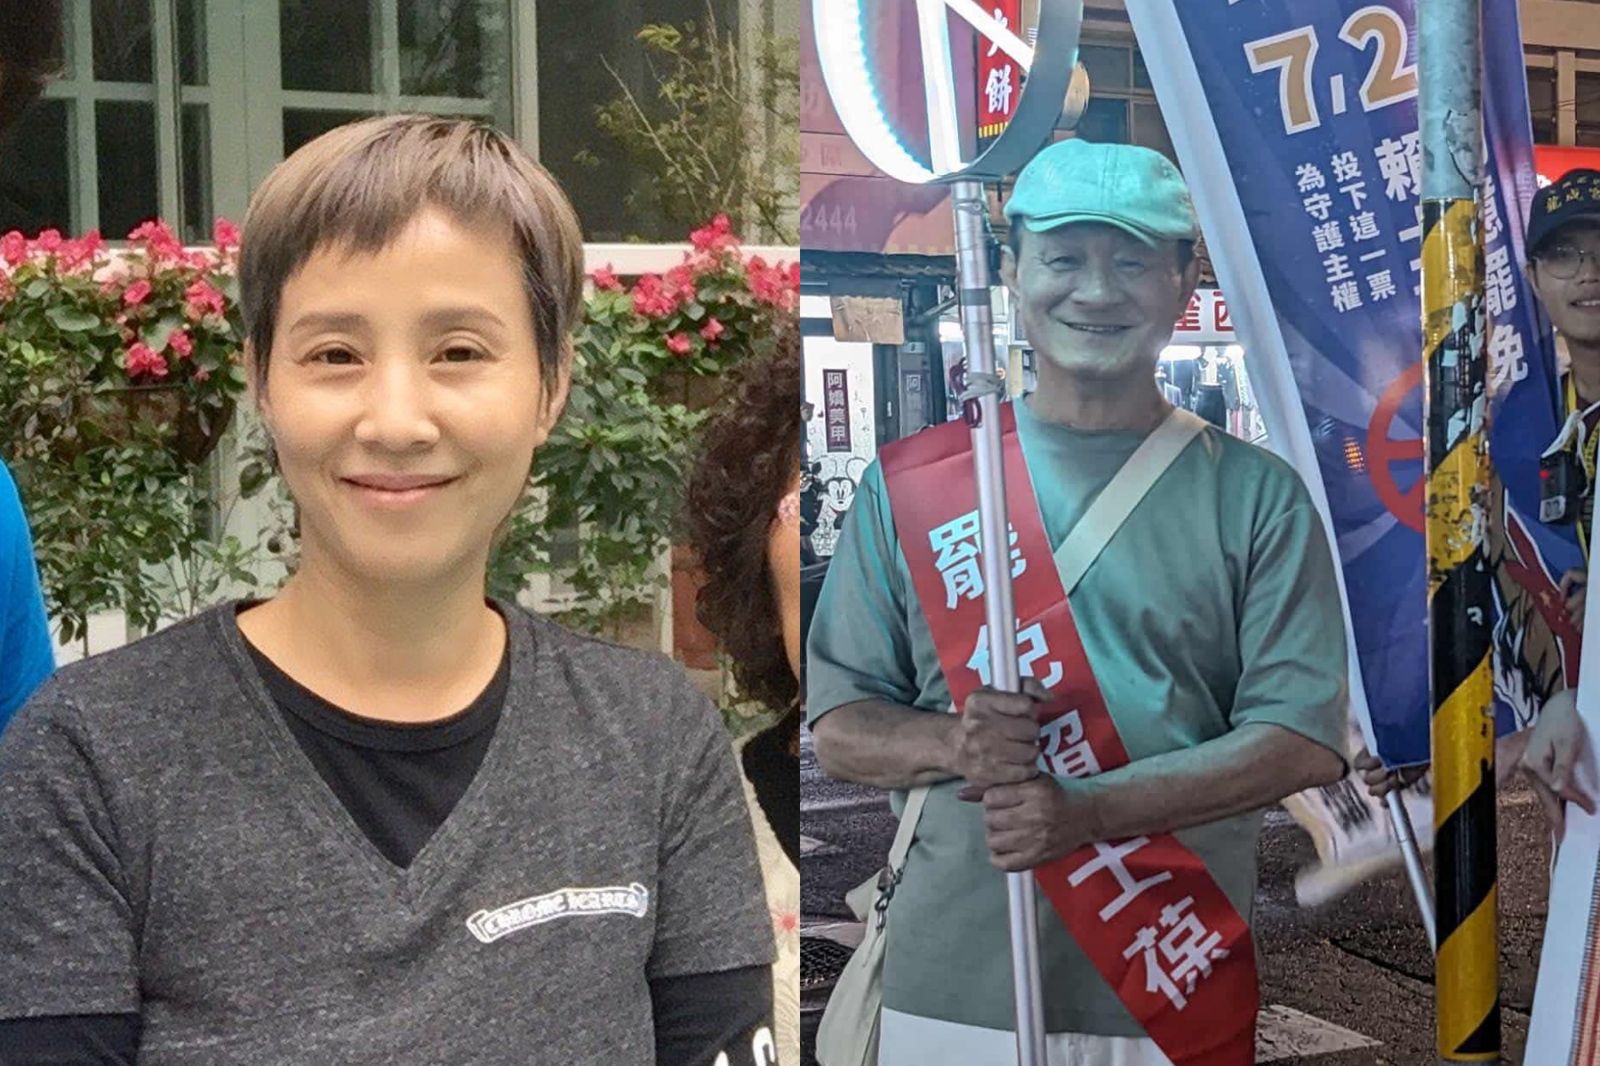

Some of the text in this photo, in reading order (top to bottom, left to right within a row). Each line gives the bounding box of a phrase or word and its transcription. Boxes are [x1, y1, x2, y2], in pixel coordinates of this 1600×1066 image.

[1295, 163, 1364, 313] 為守護主權
[1331, 151, 1396, 302] 投下這一票
